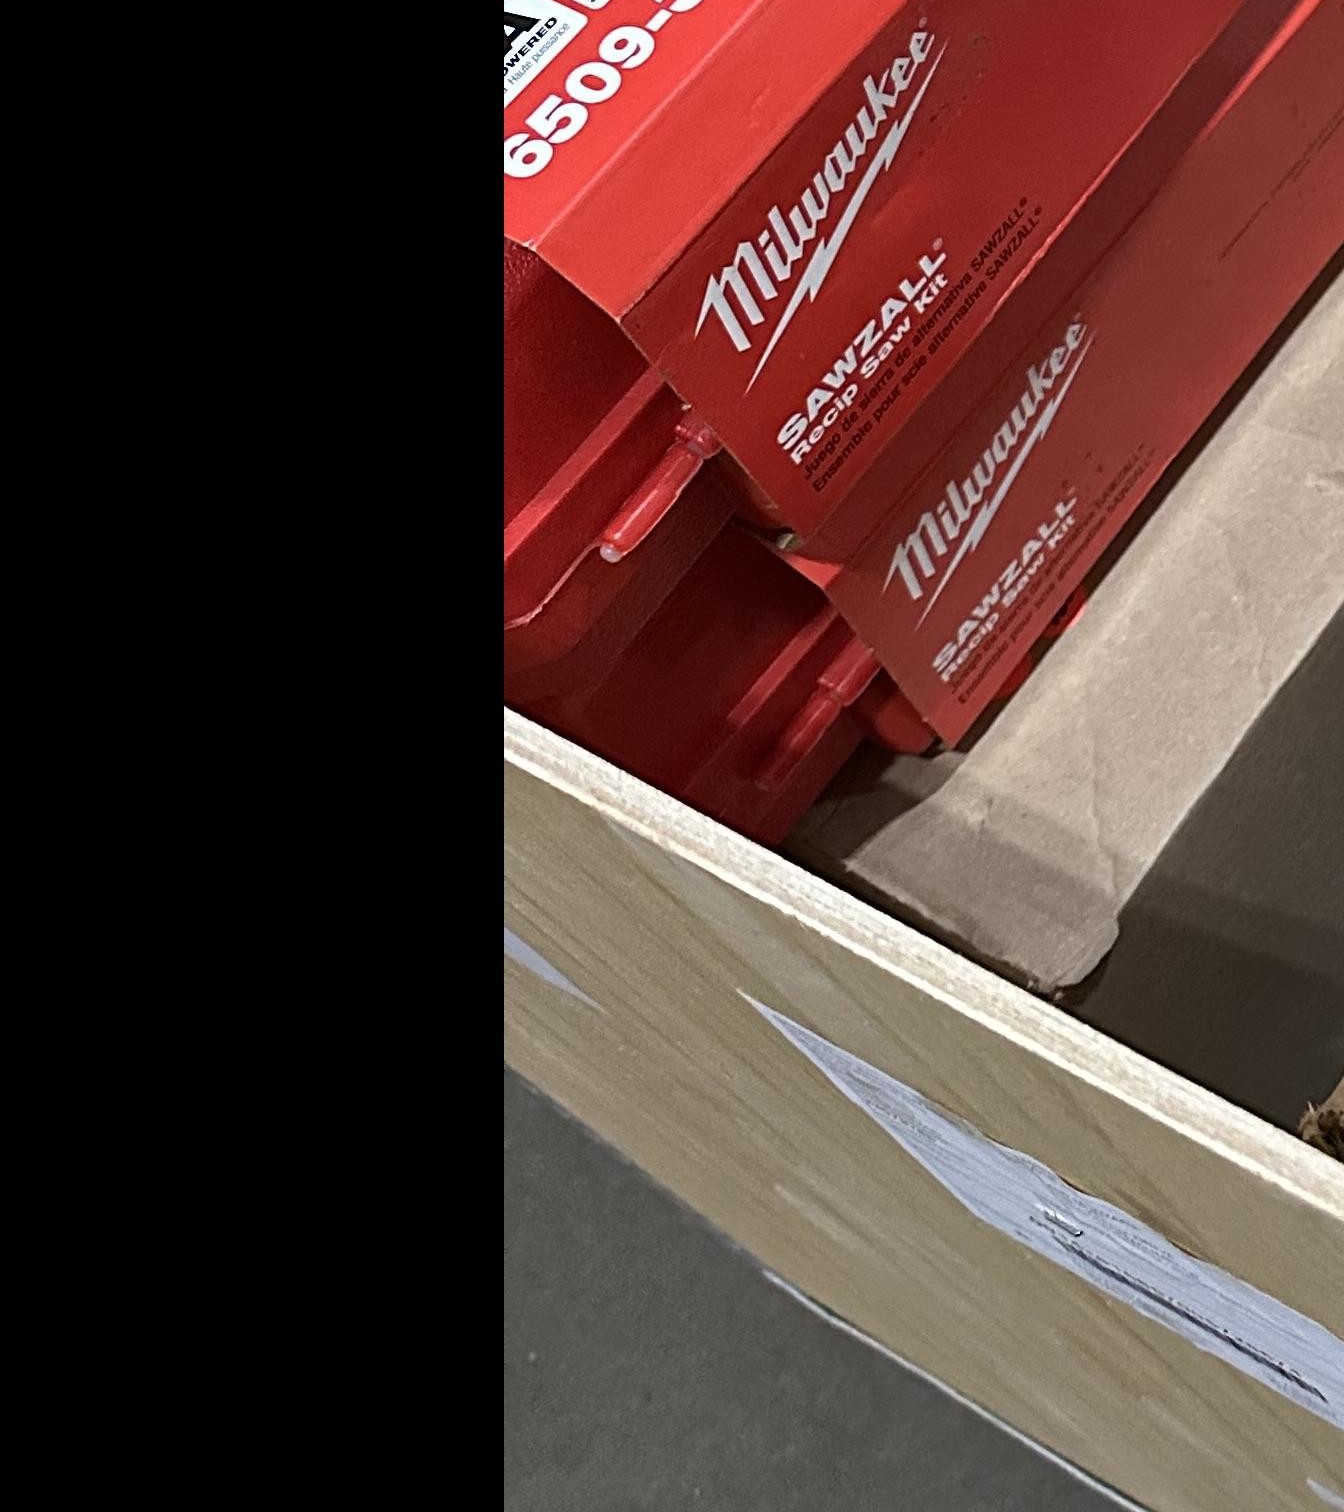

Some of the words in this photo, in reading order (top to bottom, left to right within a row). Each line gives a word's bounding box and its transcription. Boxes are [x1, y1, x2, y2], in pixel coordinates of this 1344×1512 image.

[504, 16, 557, 76] OWERED
[693, 28, 936, 354] Milwaukee
[788, 383, 860, 465] Recip
[859, 315, 912, 379] Saw
[913, 271, 950, 315] Kit
[803, 433, 842, 482] Juego
[842, 407, 860, 432] de
[882, 320, 1089, 601] Milwaukee
[939, 612, 1001, 684] Recip
[1002, 551, 1045, 608] Saw
[1046, 515, 1077, 552] Kit
